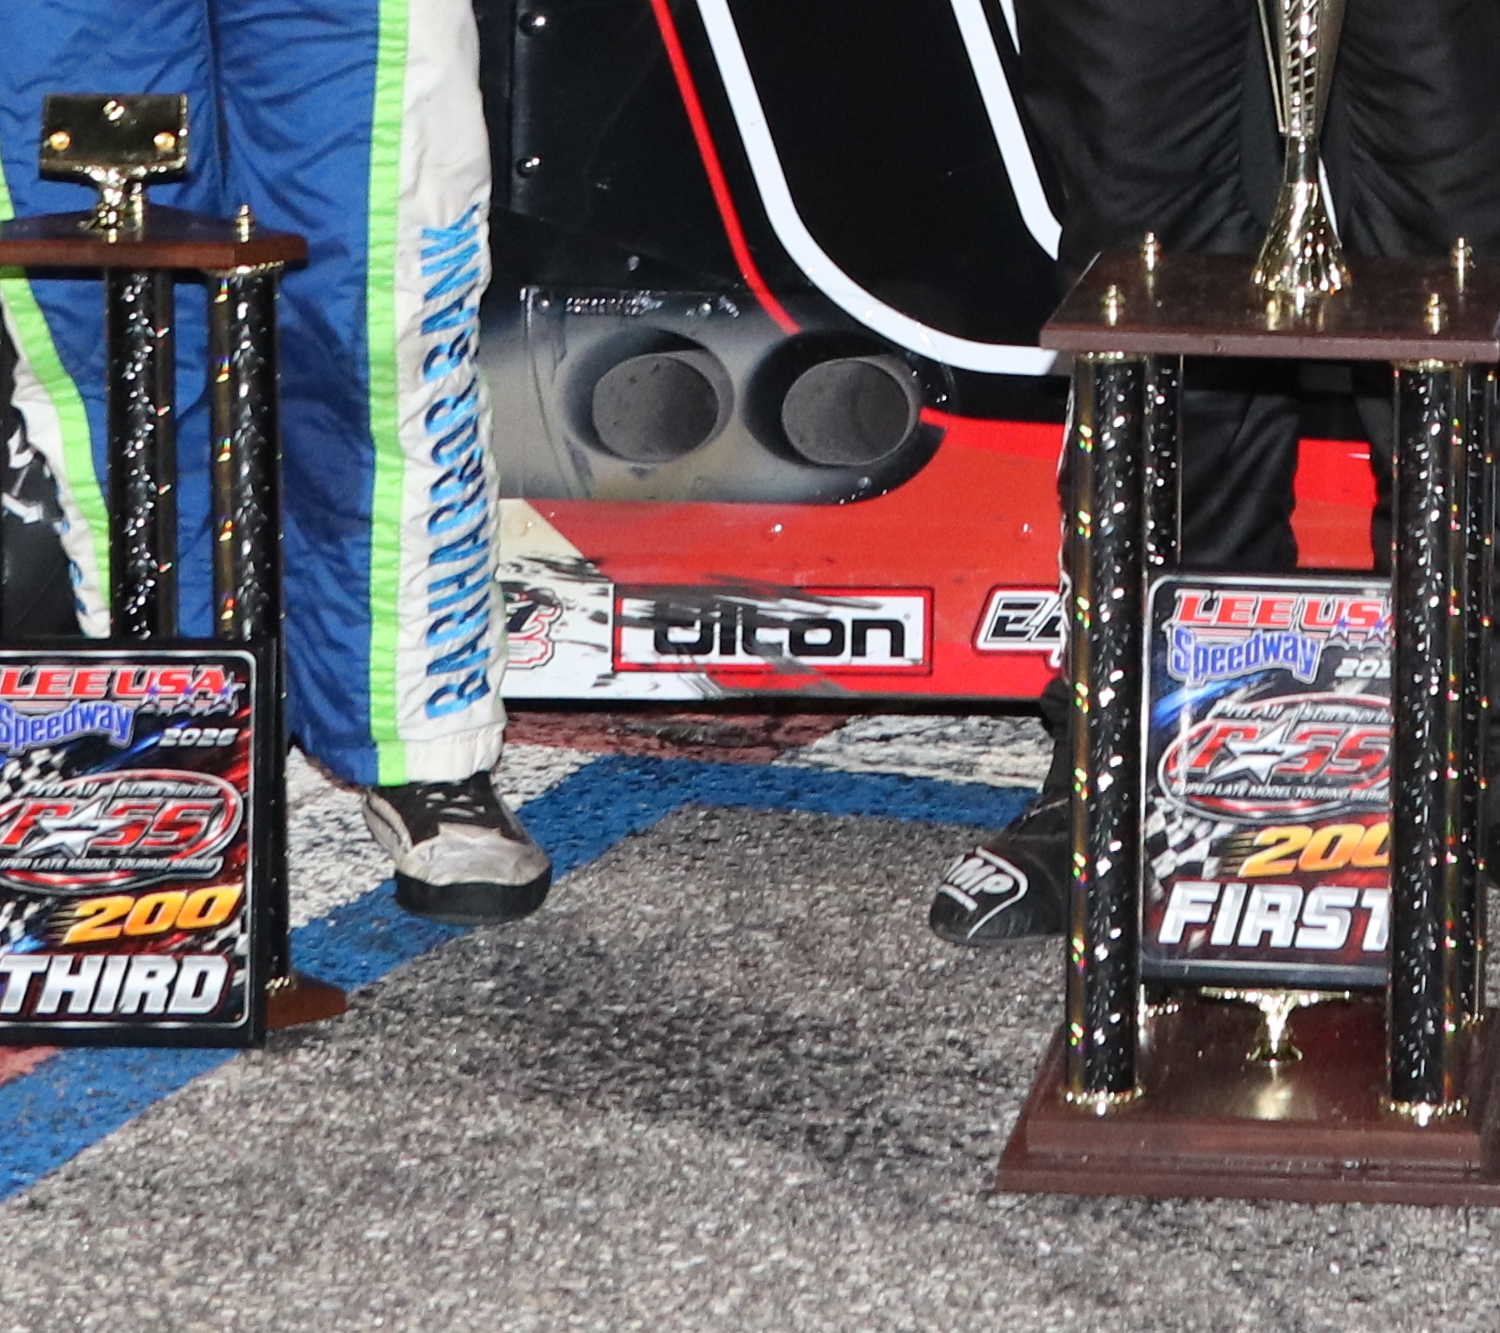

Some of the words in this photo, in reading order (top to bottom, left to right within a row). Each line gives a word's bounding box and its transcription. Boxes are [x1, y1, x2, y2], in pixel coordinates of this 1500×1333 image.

[1174, 591, 1298, 629] LEE
[1299, 595, 1391, 630] US
[1171, 627, 1323, 683] Speedway
[112, 666, 234, 699] USA
[1213, 785, 1246, 799] LATE
[1247, 785, 1292, 800] MODEL
[31, 856, 67, 870] LATE
[68, 856, 113, 870] MODEL
[114, 856, 170, 870] TOURING
[169, 856, 219, 871] SERIES
[62, 884, 244, 946] 200
[1156, 882, 1391, 953] FIRST
